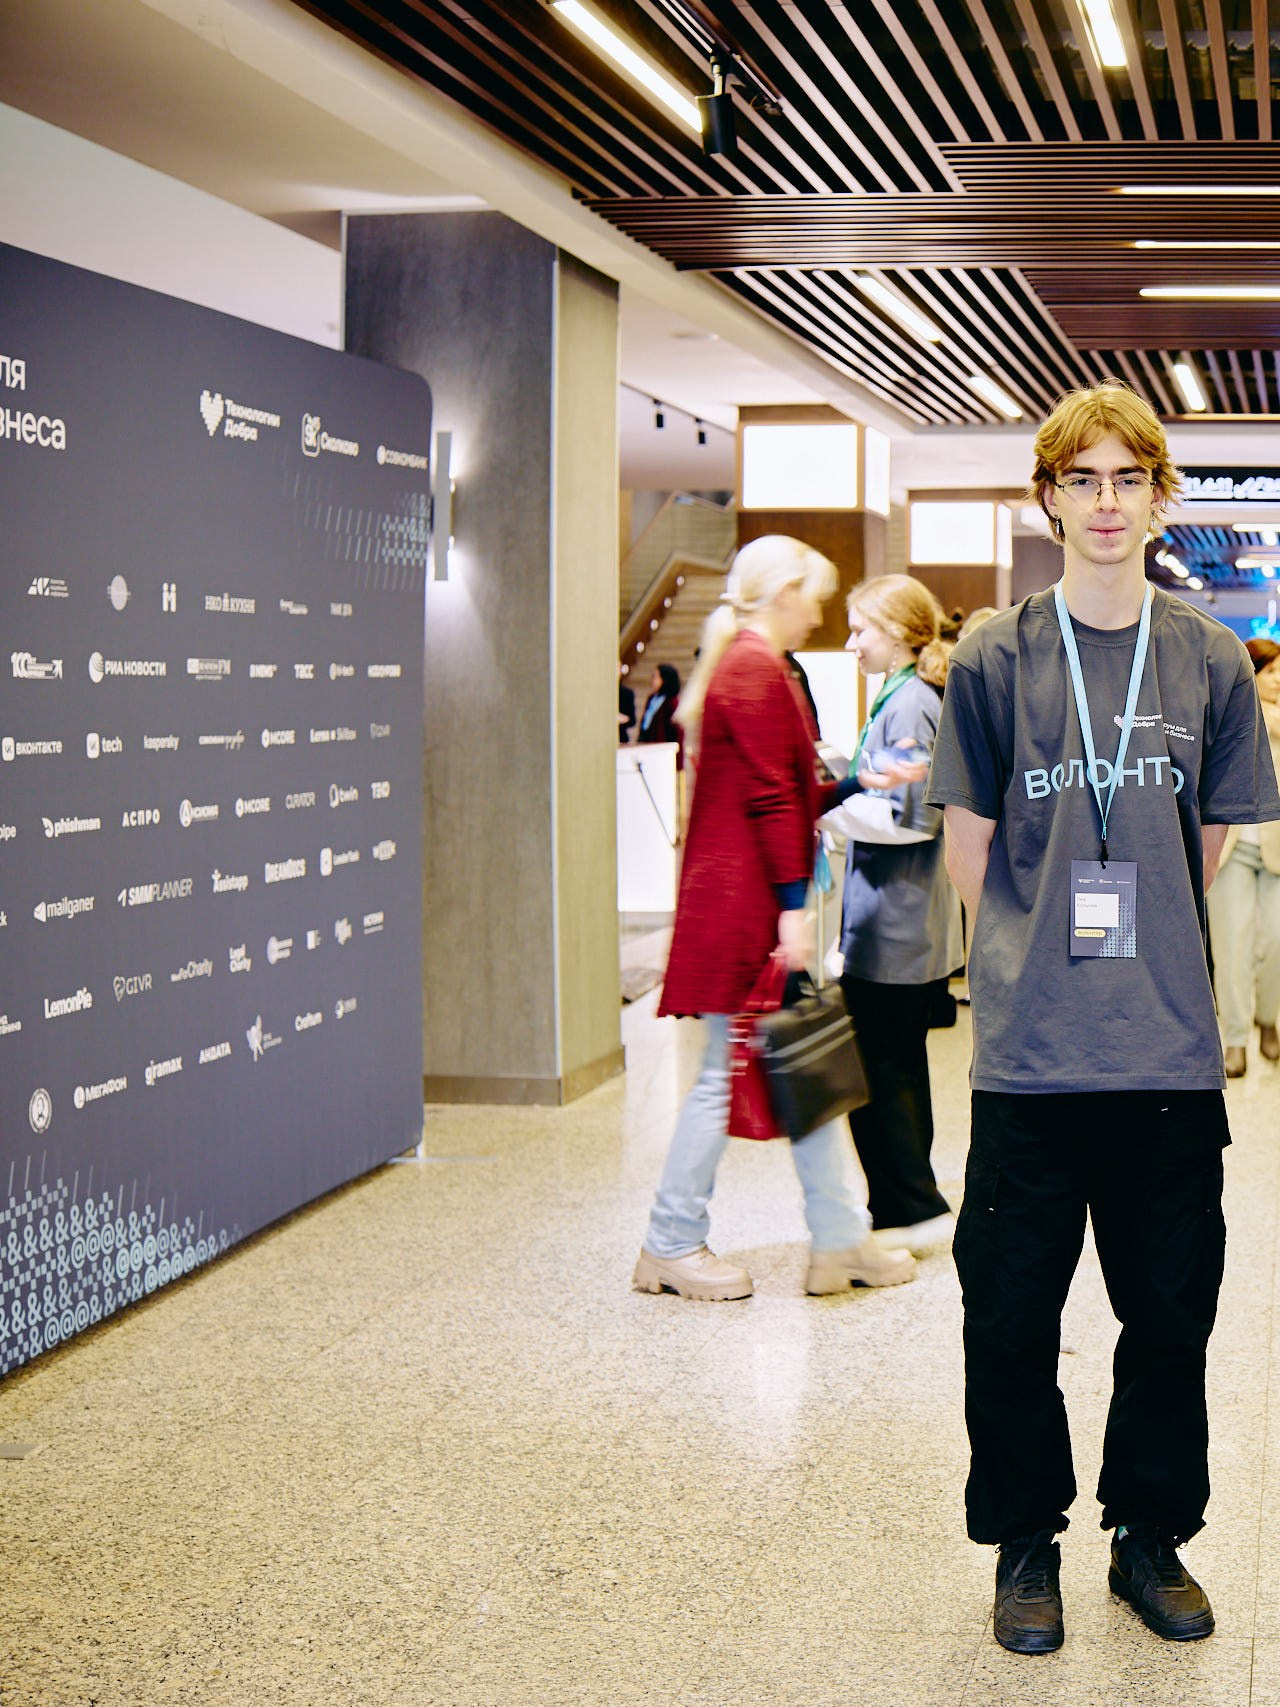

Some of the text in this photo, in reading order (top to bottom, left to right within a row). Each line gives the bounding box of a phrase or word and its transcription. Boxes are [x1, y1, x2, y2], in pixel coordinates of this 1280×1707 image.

[125, 661, 166, 677] НОВОСТИ
[102, 736, 122, 753] tech
[54, 816, 101, 837] phishman
[122, 808, 161, 828] АСПРО
[46, 896, 94, 919] mailganer
[45, 986, 93, 1019] LemonPie
